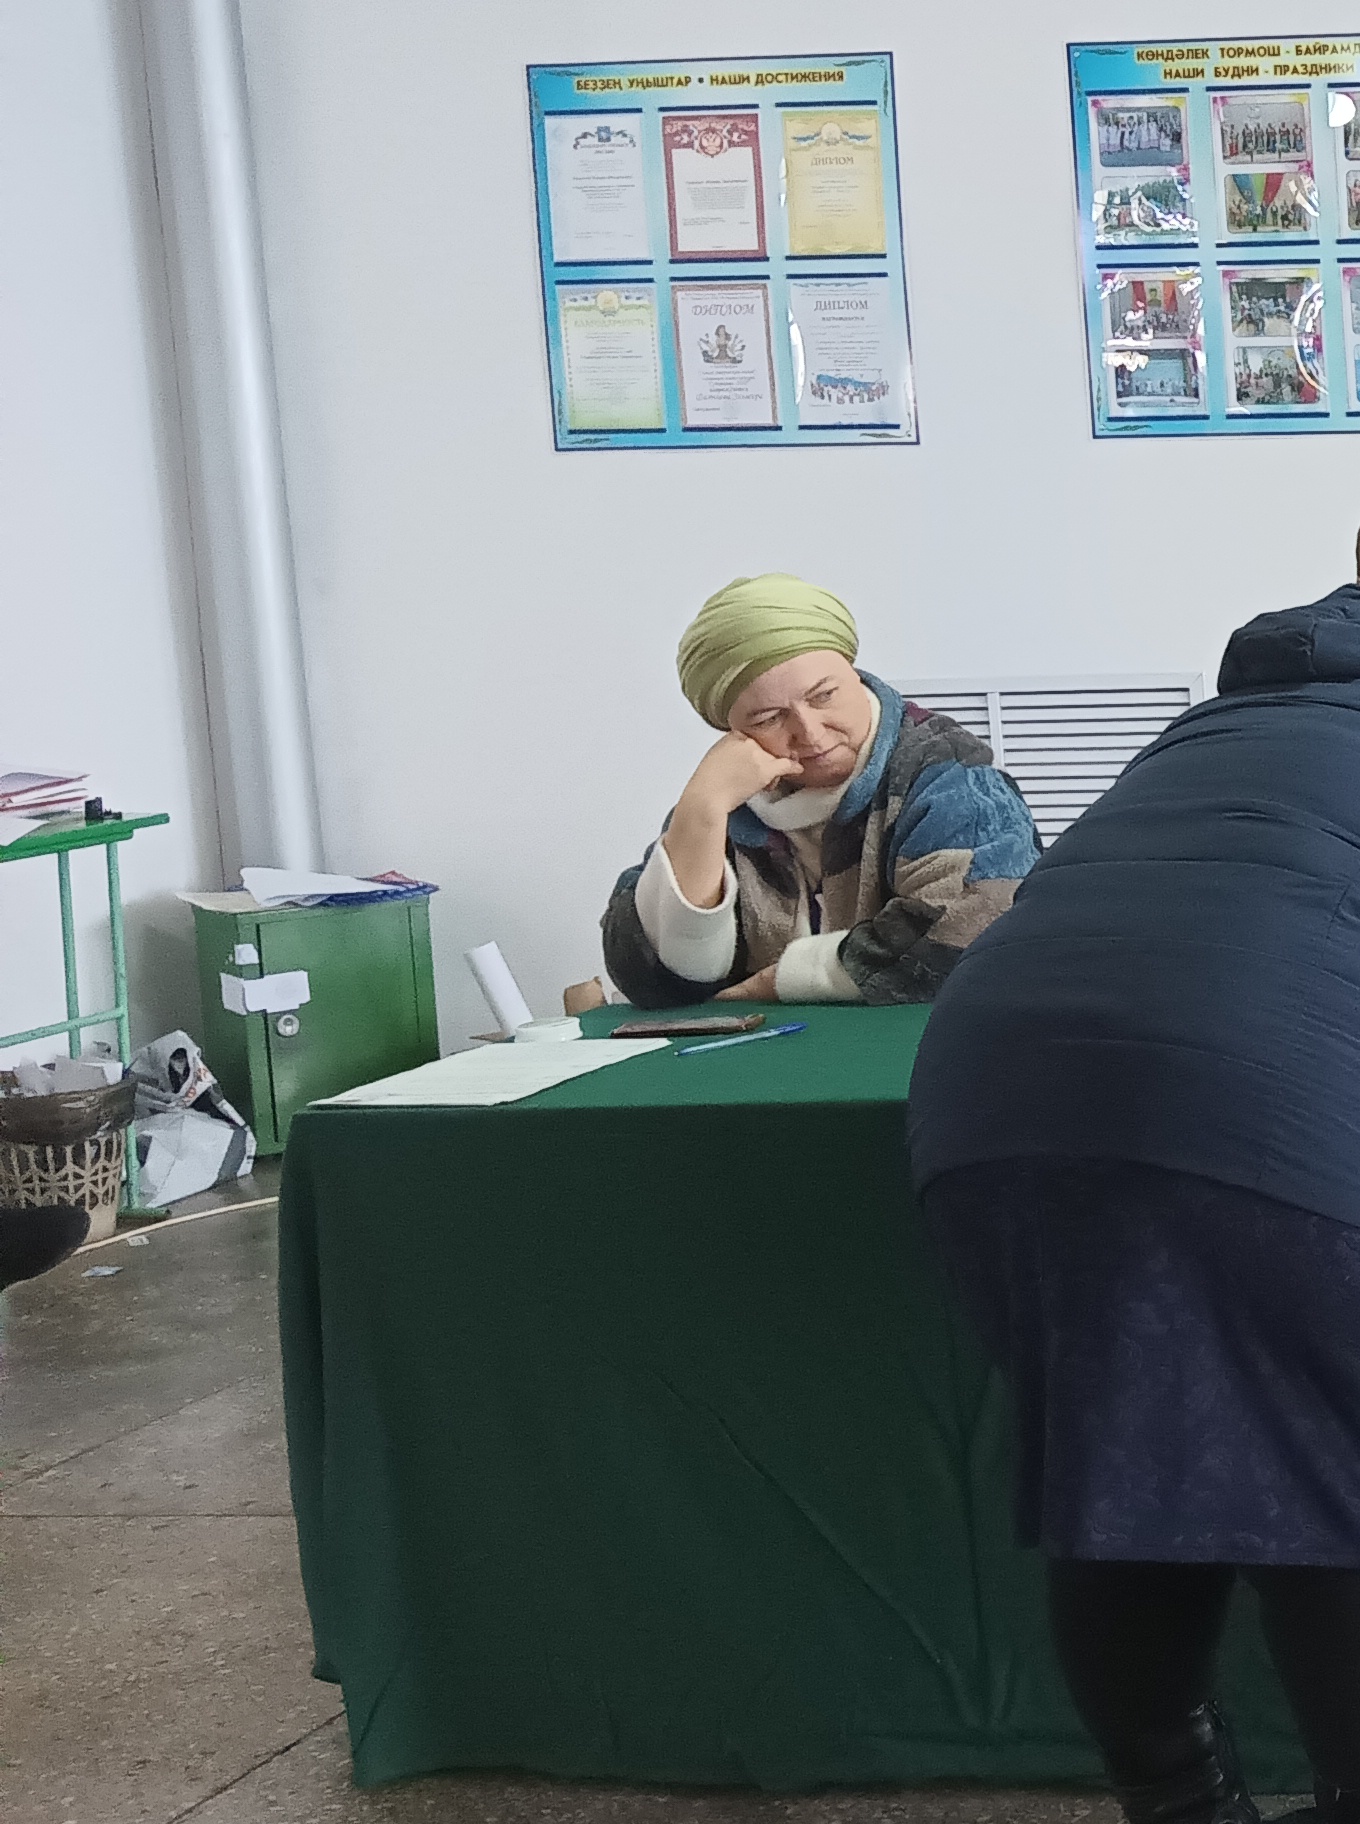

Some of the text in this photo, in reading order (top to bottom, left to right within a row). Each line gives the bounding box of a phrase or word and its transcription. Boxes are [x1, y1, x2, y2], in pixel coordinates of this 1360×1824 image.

[1136, 48, 1210, 62] КӨНДӘЛЕК
[1219, 45, 1281, 58] ТОРМОШ
[709, 71, 844, 87] НАШИ ДОСТИЖЕНИЯ
[1163, 66, 1205, 79] НАШИ
[1214, 64, 1260, 79] БУДНИ
[1273, 62, 1355, 76] ПРАЗДНИКИ
